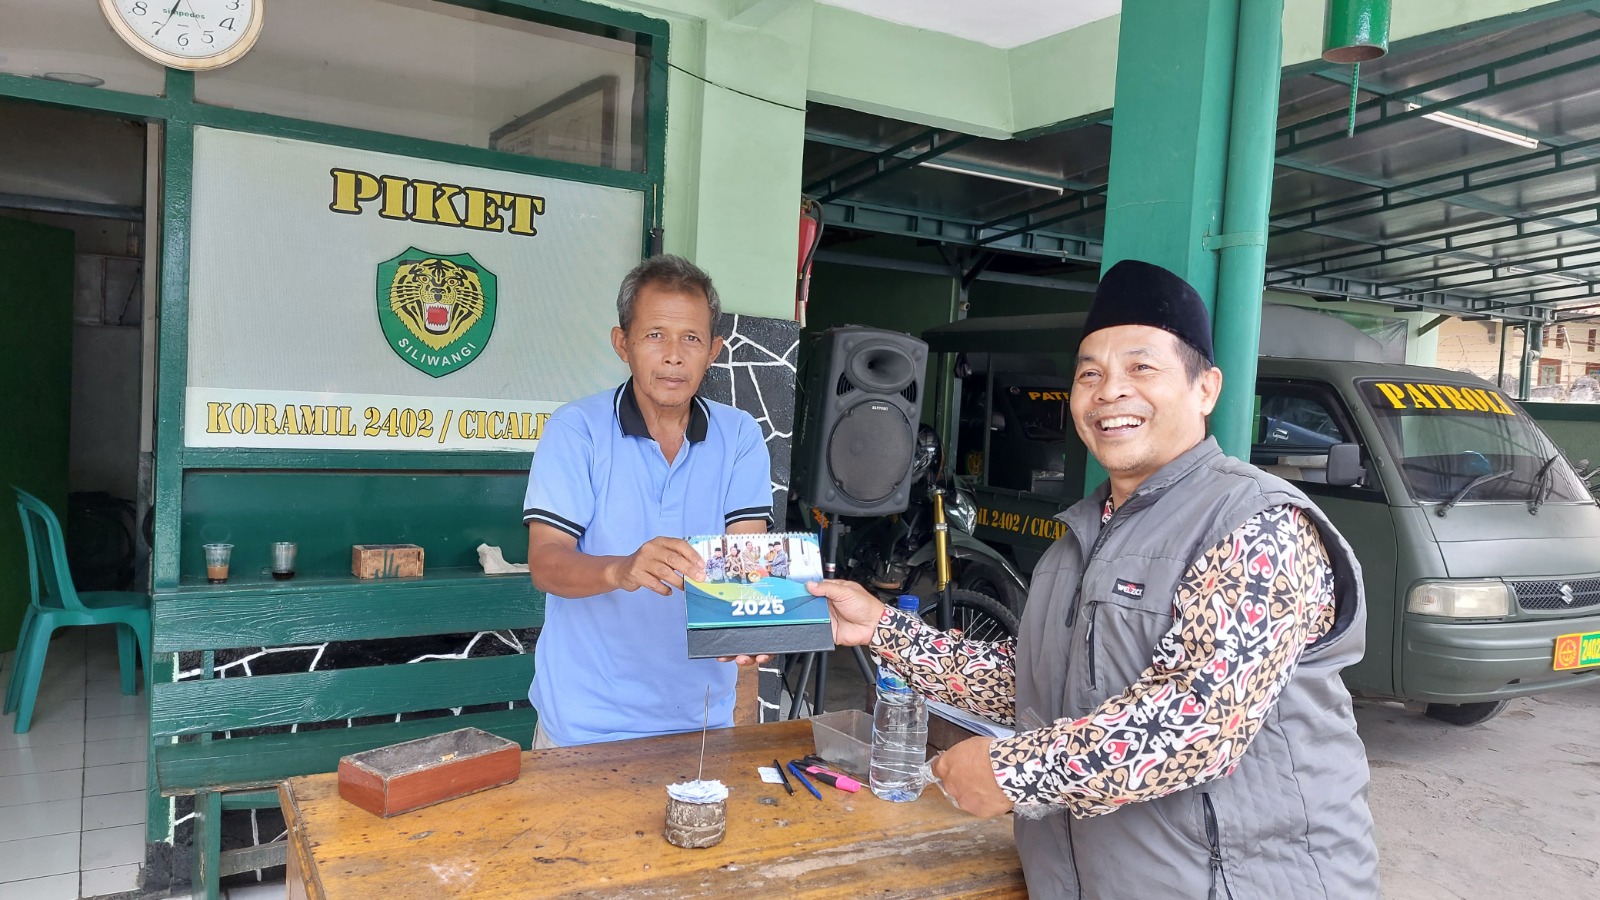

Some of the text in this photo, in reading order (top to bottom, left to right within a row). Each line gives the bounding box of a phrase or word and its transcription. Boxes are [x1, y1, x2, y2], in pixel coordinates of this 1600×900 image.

[132, 1, 148, 16] 8
[218, 17, 234, 31] 4
[177, 33, 189, 46] 6
[201, 30, 214, 44] 5
[329, 168, 545, 236] PIKET
[398, 338, 476, 366] SILIWANGI
[1375, 383, 1516, 416] PATROLI
[206, 402, 356, 436] KORAMIL
[363, 406, 434, 438] 2402
[438, 410, 453, 443] /
[991, 510, 1020, 531] 2402
[1021, 515, 1029, 535] /
[731, 599, 785, 616] 2025
